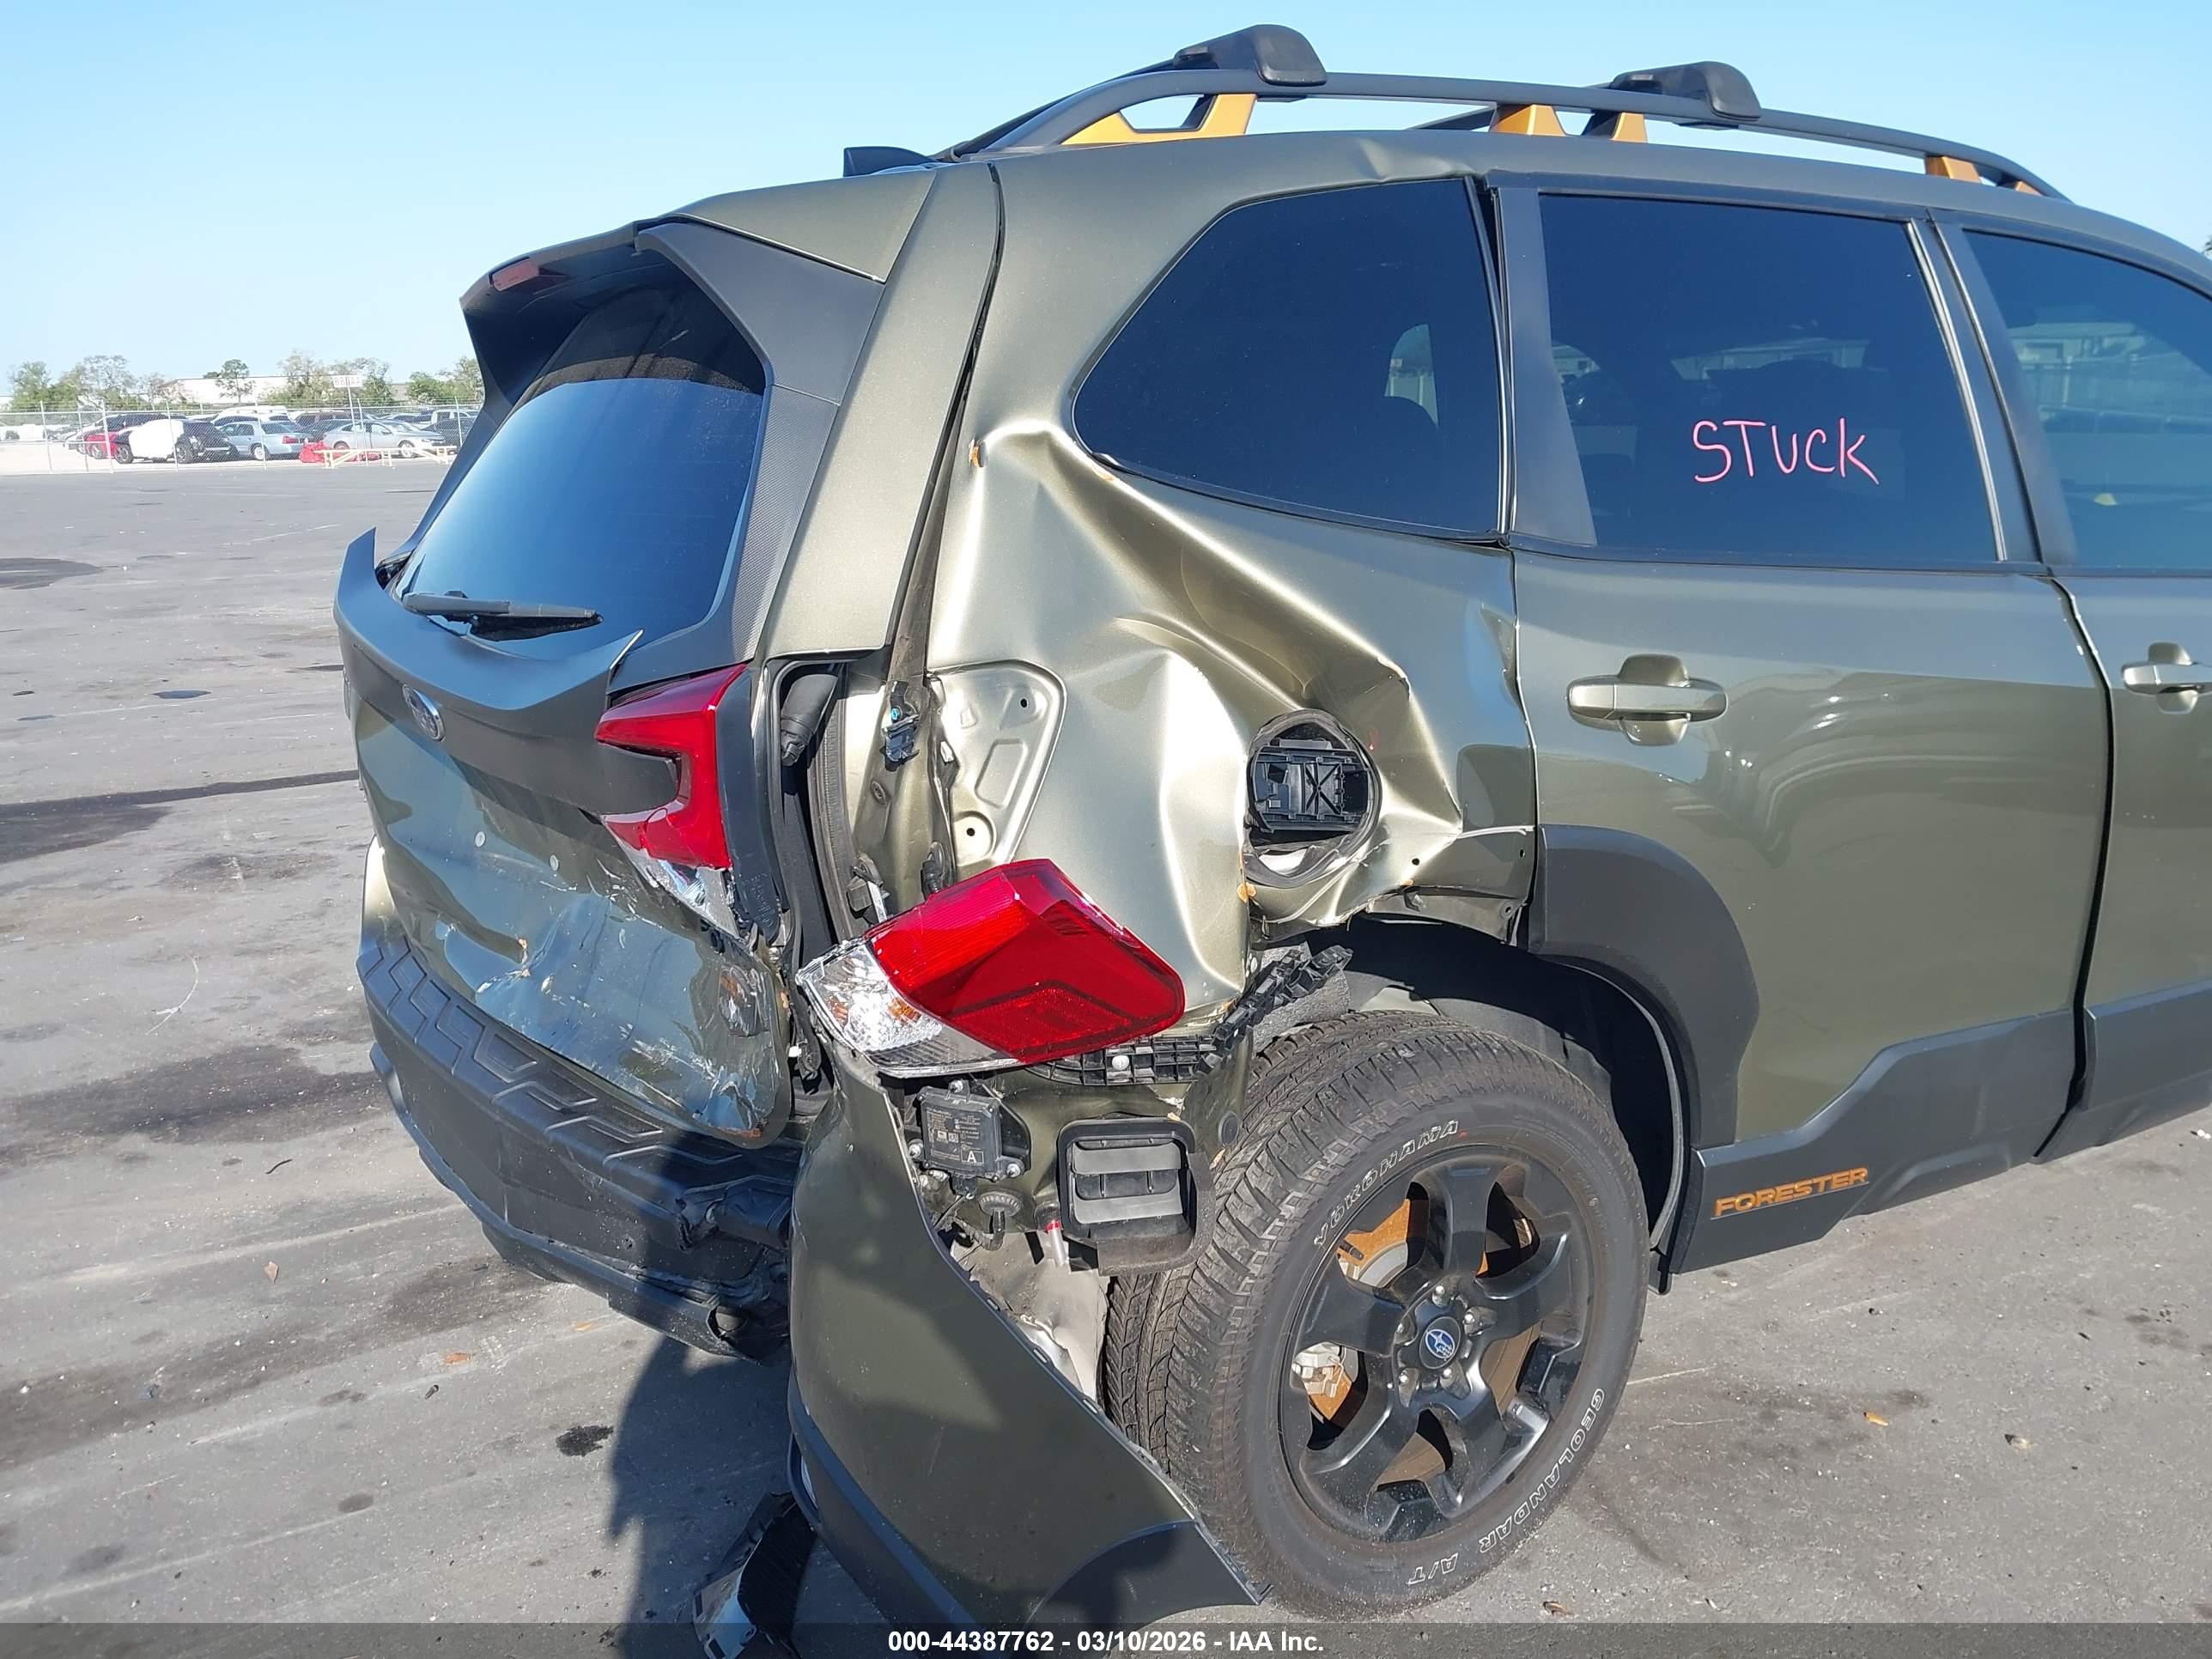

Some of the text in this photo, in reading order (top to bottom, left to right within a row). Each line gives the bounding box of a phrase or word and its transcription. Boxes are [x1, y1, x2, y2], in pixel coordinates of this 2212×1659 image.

[1692, 417, 1880, 485] STUCK
[967, 1151, 977, 1164] A
[1313, 1120, 1459, 1245] YOKOHAMA
[1714, 1166, 1869, 1218] FORESTER
[1407, 1388, 1606, 1586] GEOLANDAR A/T
